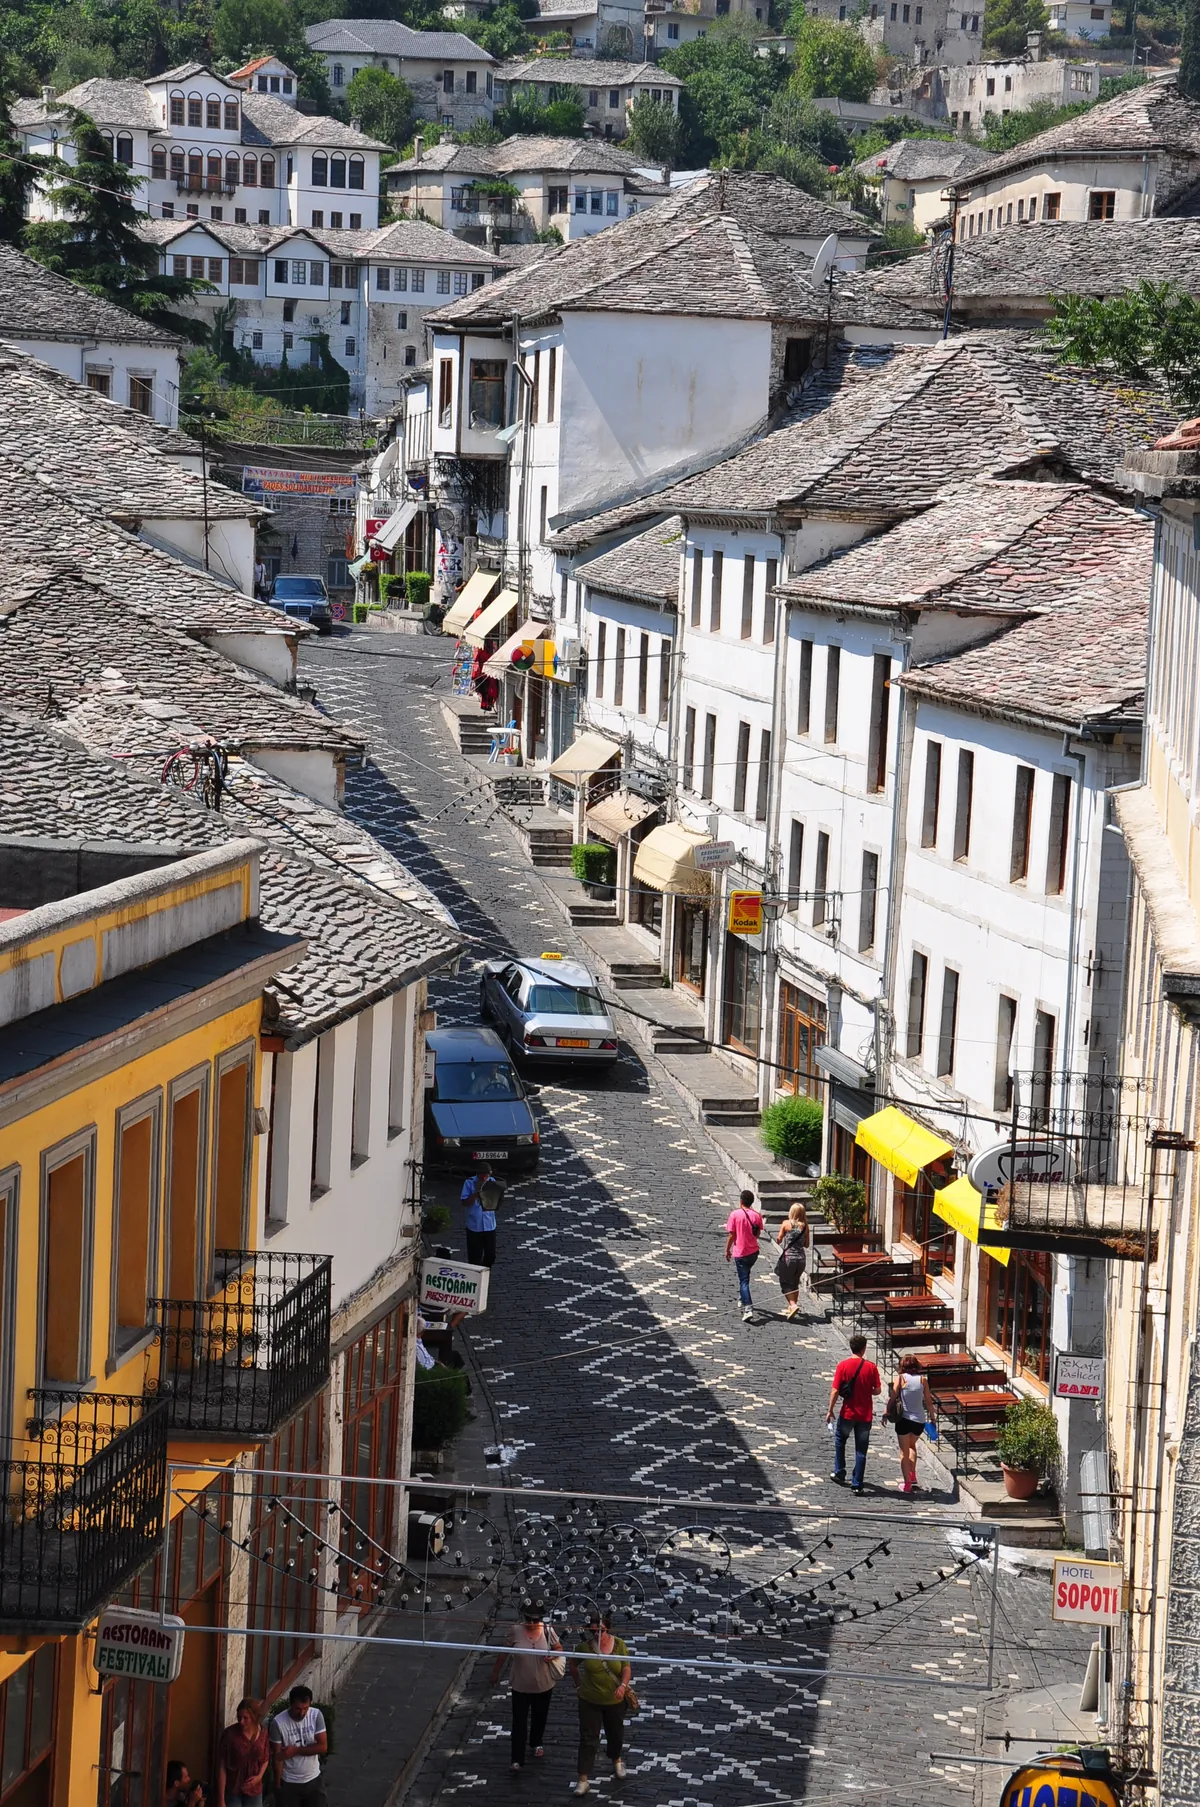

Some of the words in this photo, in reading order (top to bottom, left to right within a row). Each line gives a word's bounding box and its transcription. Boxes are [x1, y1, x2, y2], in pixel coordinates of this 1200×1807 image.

[733, 918, 758, 927] Kodak
[438, 1267, 467, 1279] Bar
[425, 1274, 477, 1294] RESTORANT
[1058, 1383, 1100, 1396] ZANI
[1062, 1566, 1095, 1579] HOTEL
[102, 1624, 173, 1650] RESTORANT
[98, 1646, 171, 1679] FESTIVALI
